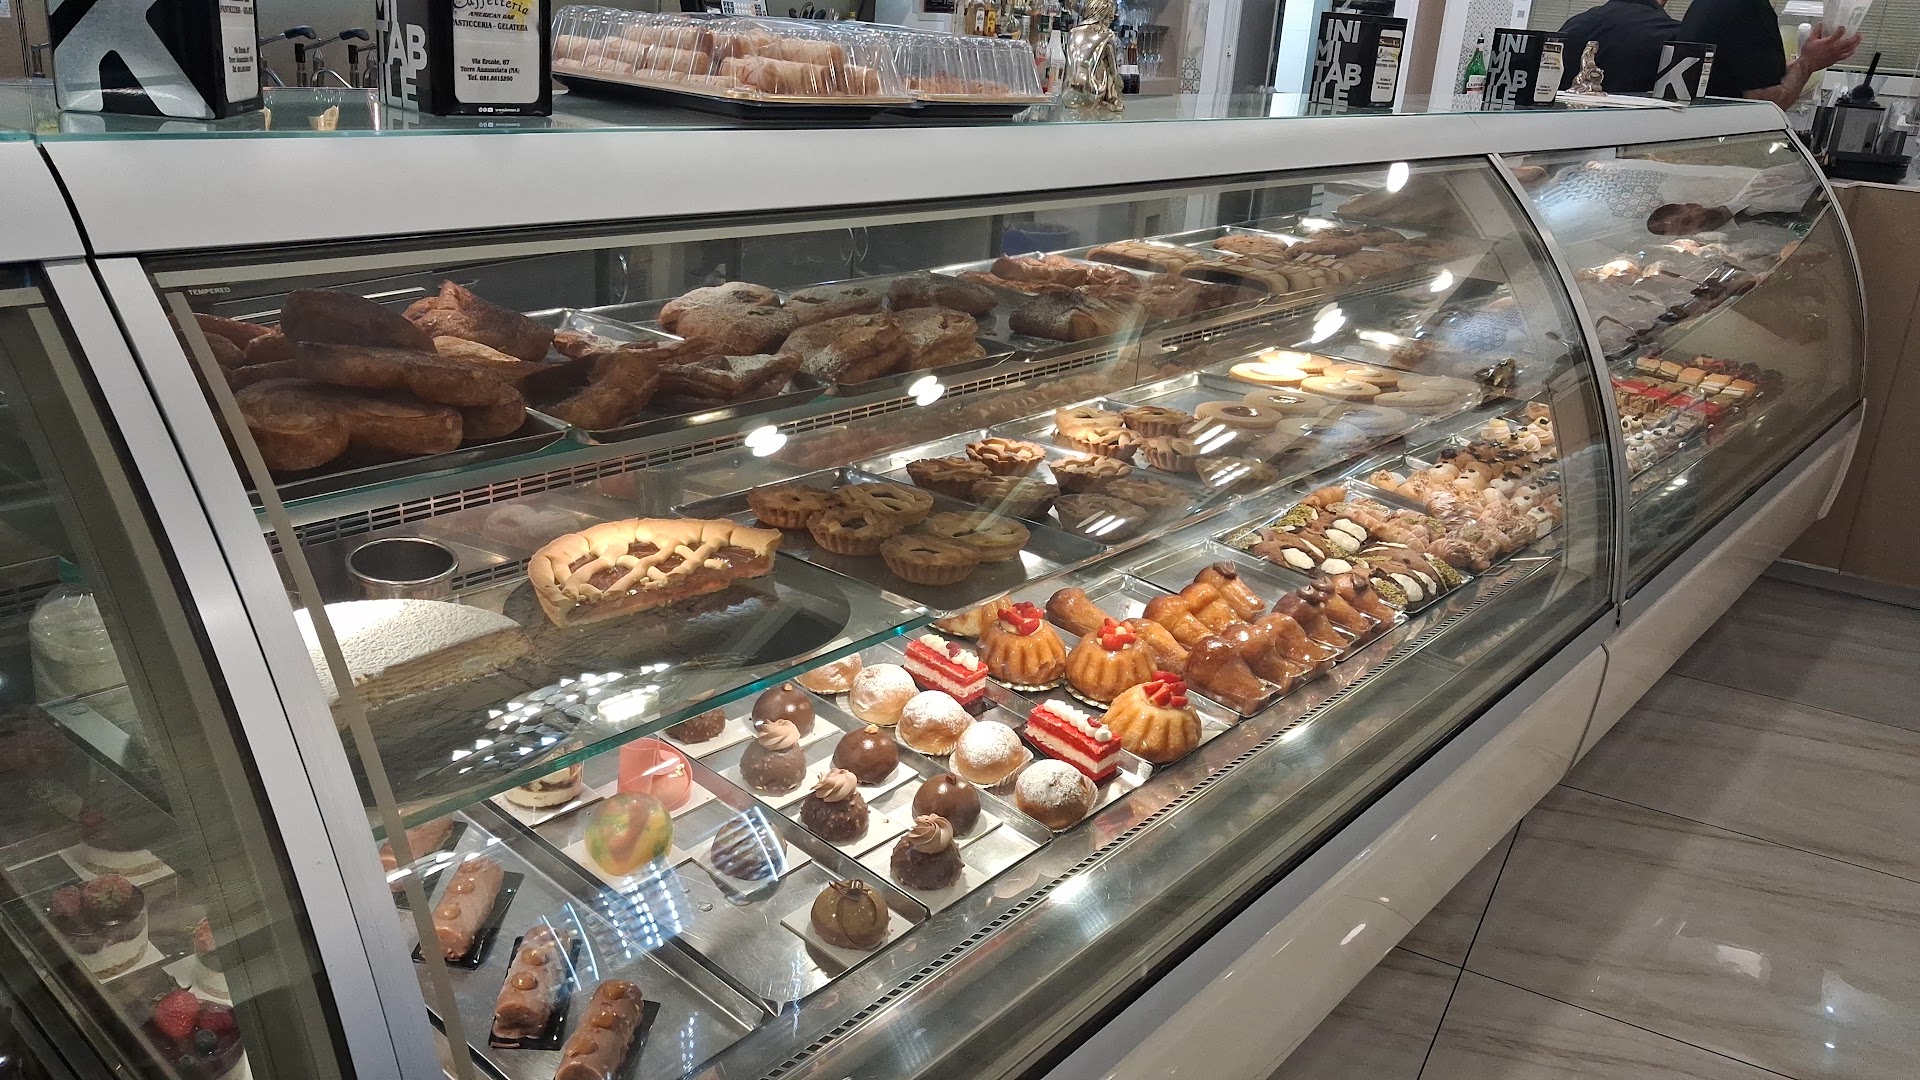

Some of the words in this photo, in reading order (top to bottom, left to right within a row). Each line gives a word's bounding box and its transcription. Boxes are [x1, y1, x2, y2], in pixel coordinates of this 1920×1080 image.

[453, 19, 493, 29] ASTICCERIA
[468, 11, 501, 19] AMERICAN
[1326, 19, 1361, 43] INI
[376, 19, 428, 71] TAB
[1499, 34, 1528, 53] INI
[1315, 60, 1362, 86] TAB
[1488, 67, 1528, 89] TAB
[1652, 44, 1701, 101] K
[187, 286, 231, 296] TEMPERED
